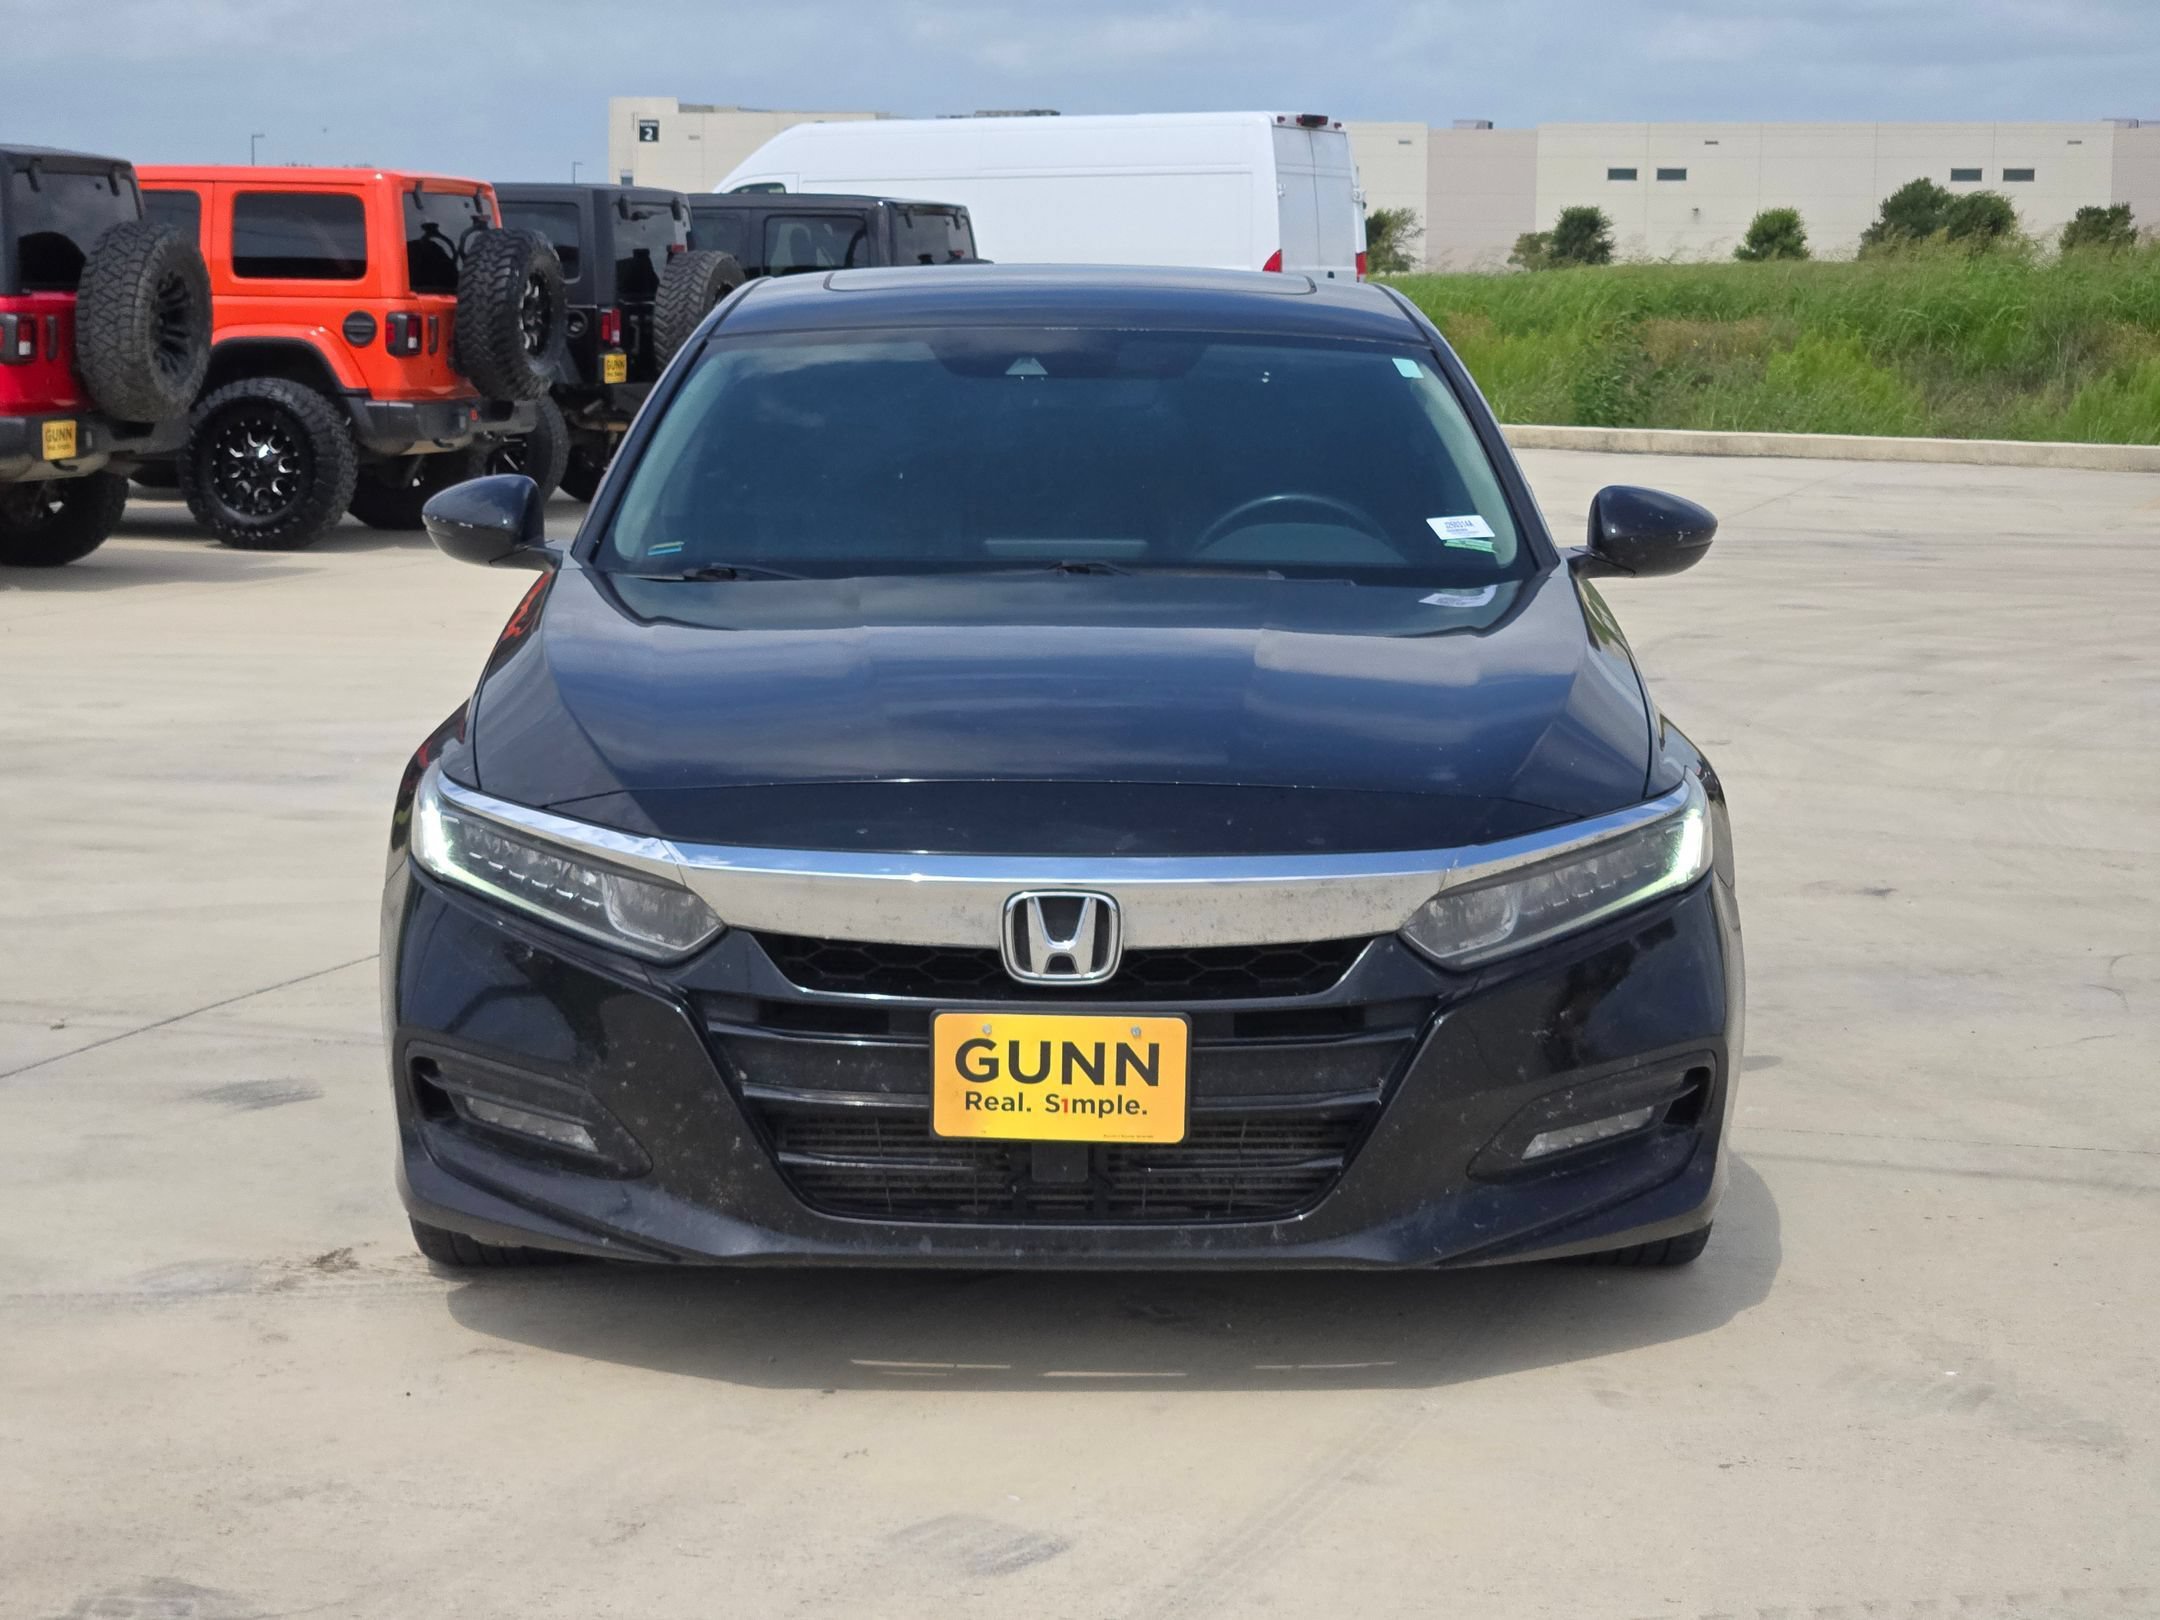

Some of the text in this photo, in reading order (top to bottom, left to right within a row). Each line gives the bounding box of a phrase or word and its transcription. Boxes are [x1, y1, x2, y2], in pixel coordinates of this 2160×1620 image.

[644, 127, 653, 141] 2
[955, 1038, 1160, 1087] GUNN
[965, 1091, 1032, 1112] Real.
